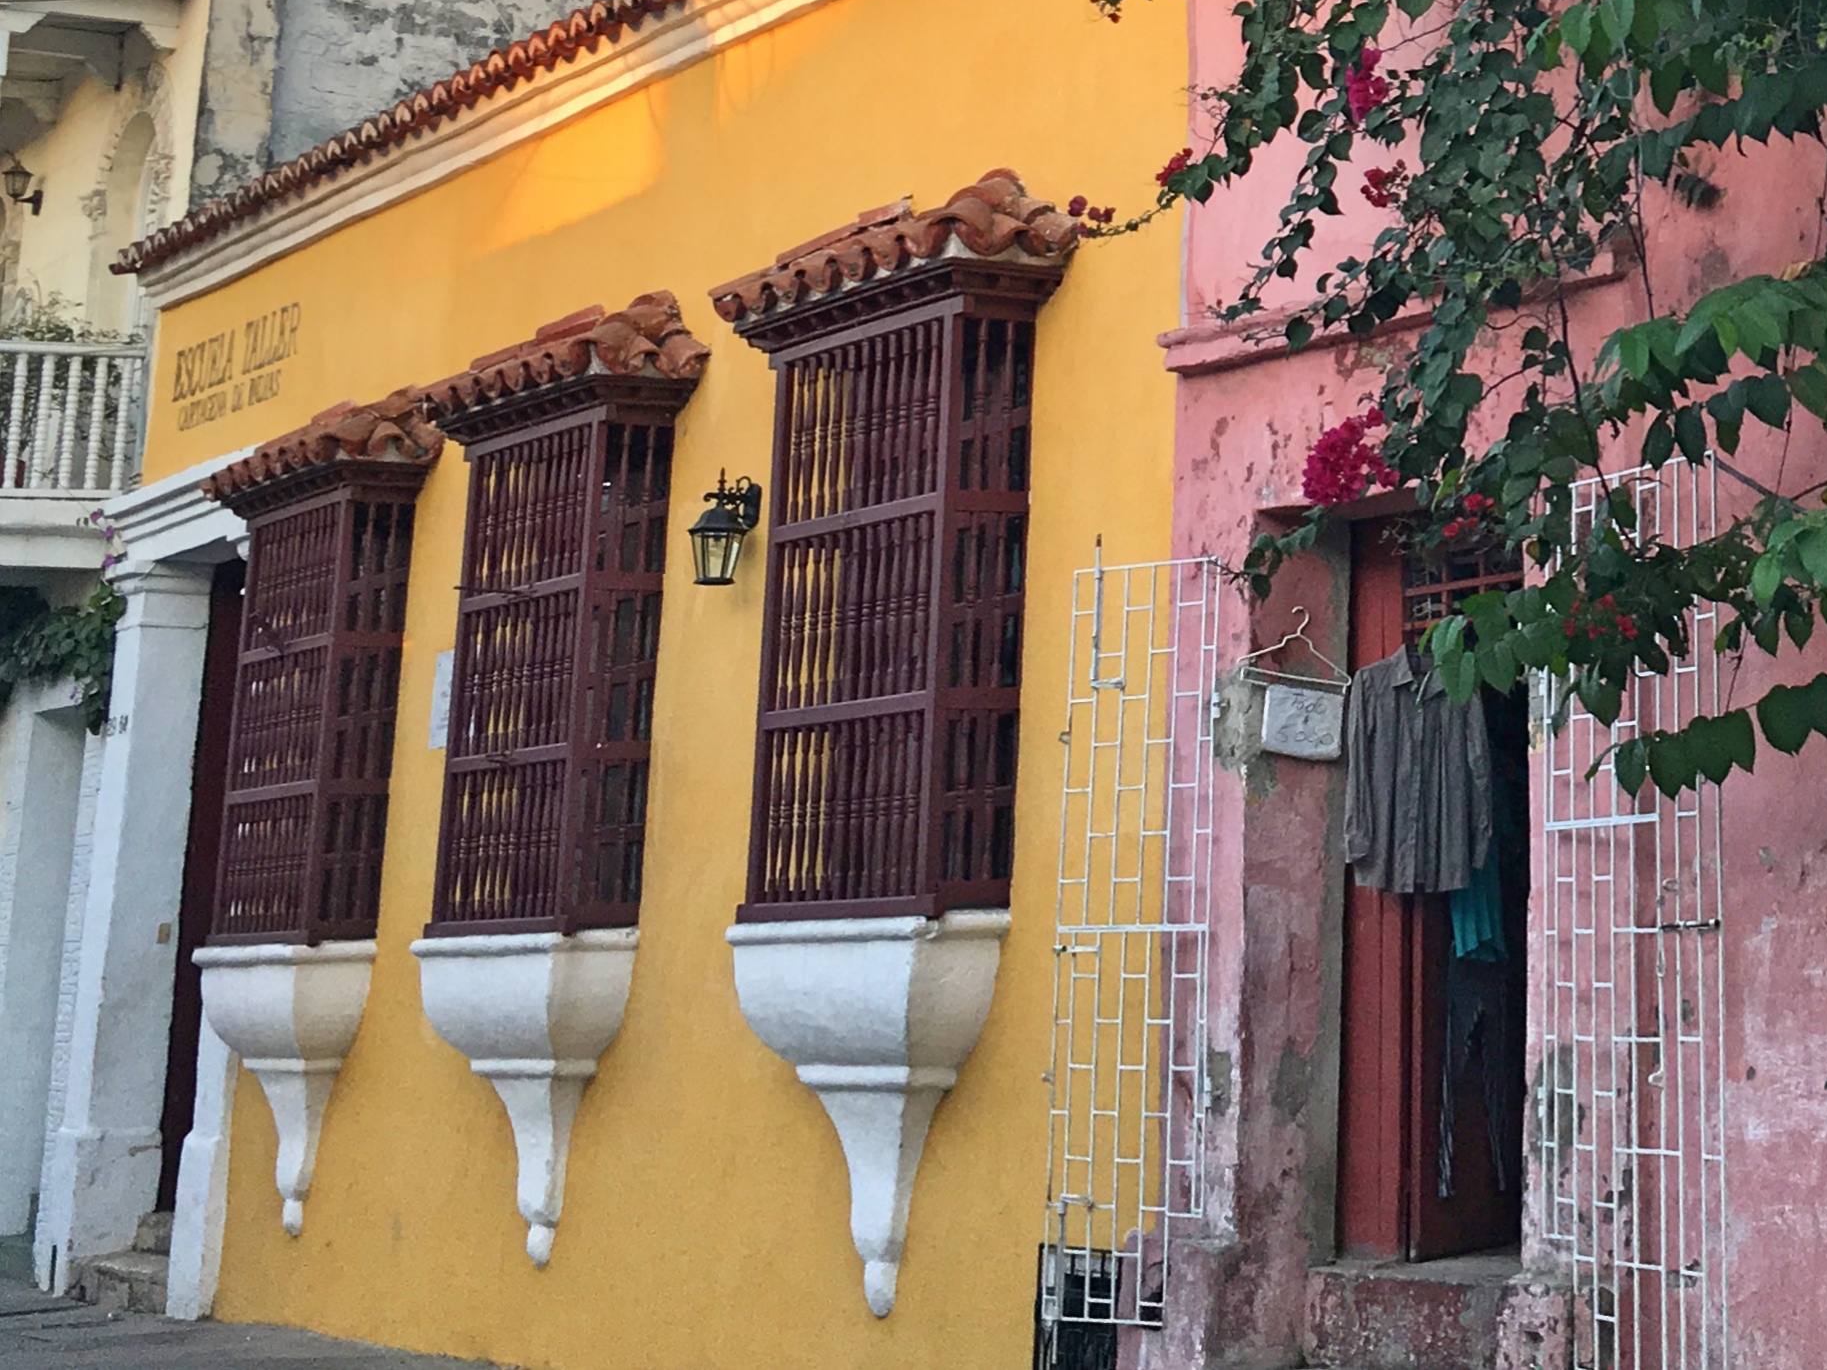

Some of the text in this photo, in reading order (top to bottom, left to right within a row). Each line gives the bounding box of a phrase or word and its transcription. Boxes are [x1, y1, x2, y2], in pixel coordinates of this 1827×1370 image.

[172, 302, 301, 402] ESCUELA TALLER
[231, 382, 244, 413] DE
